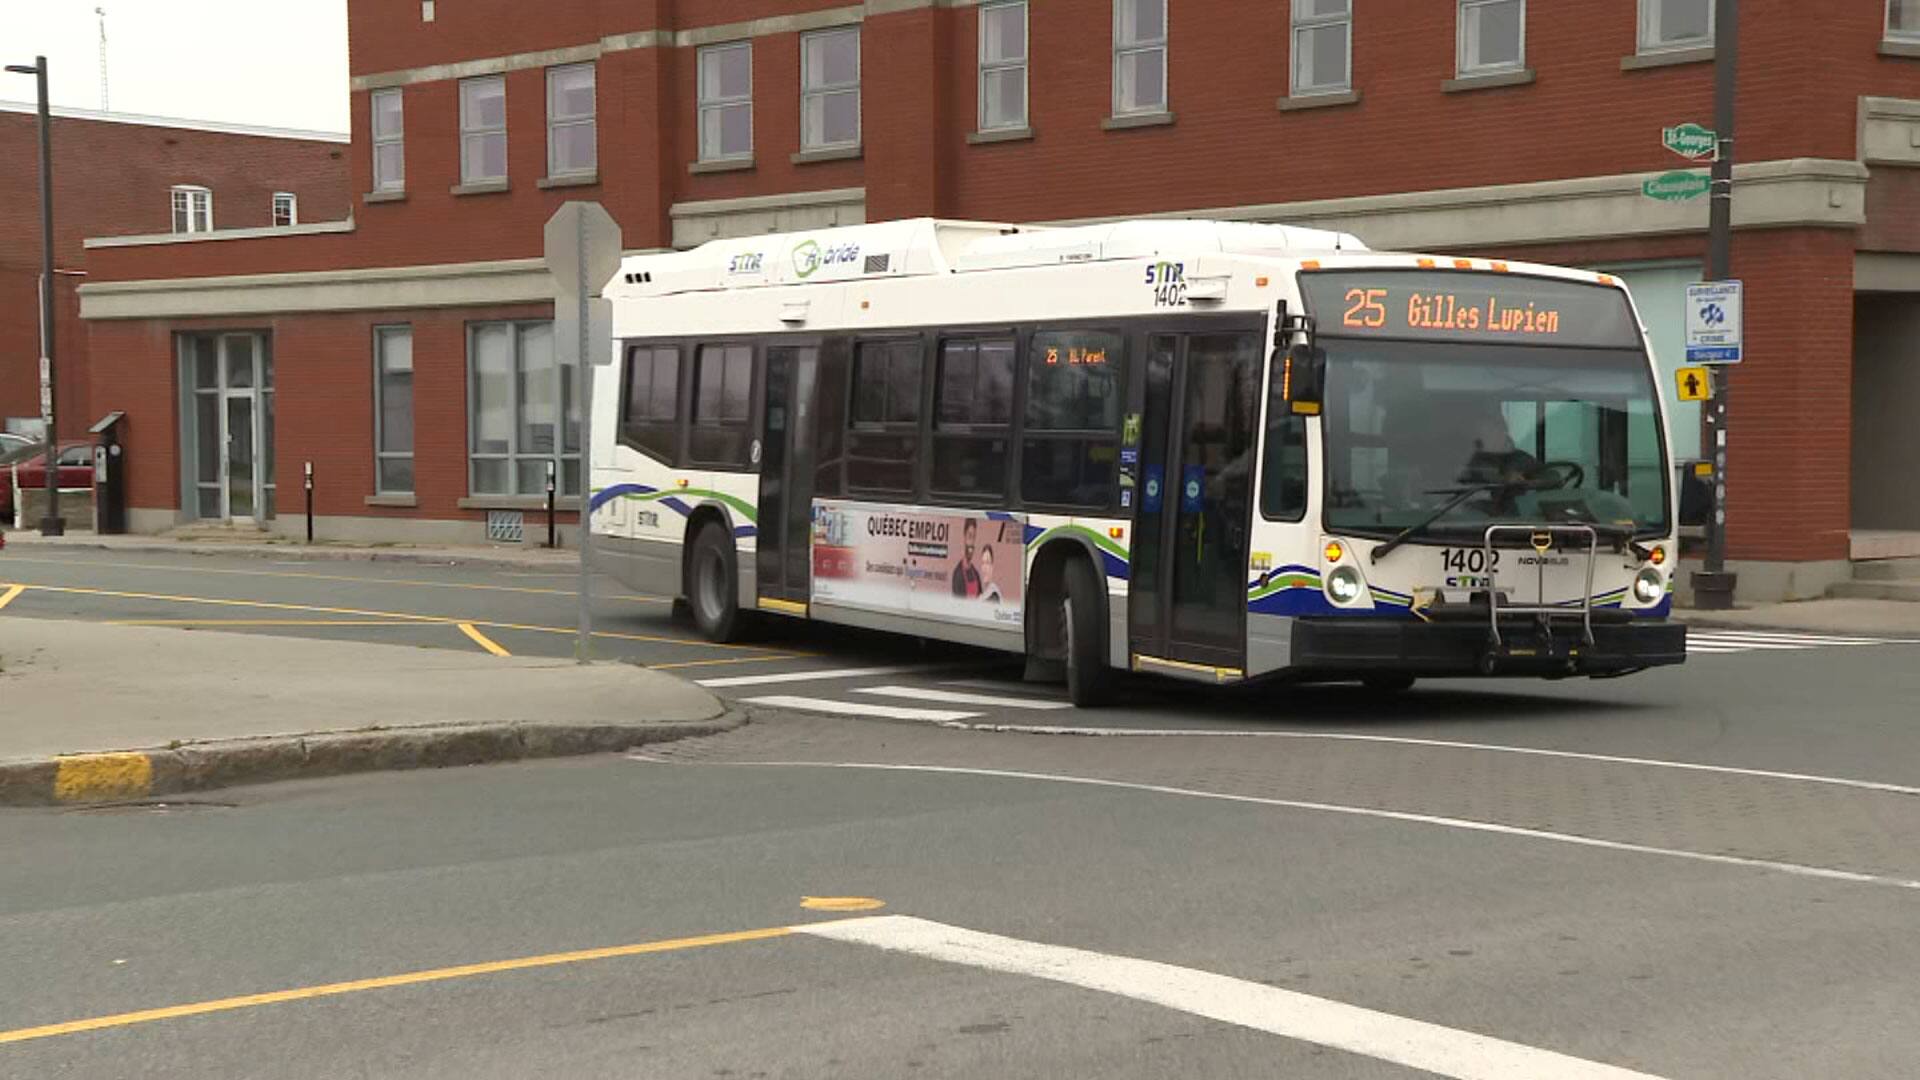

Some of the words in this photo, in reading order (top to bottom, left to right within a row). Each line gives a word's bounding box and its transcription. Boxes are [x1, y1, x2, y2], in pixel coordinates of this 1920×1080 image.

[1154, 283, 1187, 306] 1402
[1343, 288, 1388, 328] 25
[1407, 293, 1480, 331] Gilles
[1488, 297, 1559, 334] Lupien
[1047, 348, 1057, 363] 25
[867, 513, 908, 536] QUÉBEC
[908, 520, 949, 542] EMPLOI
[1440, 548, 1500, 573] 1402
